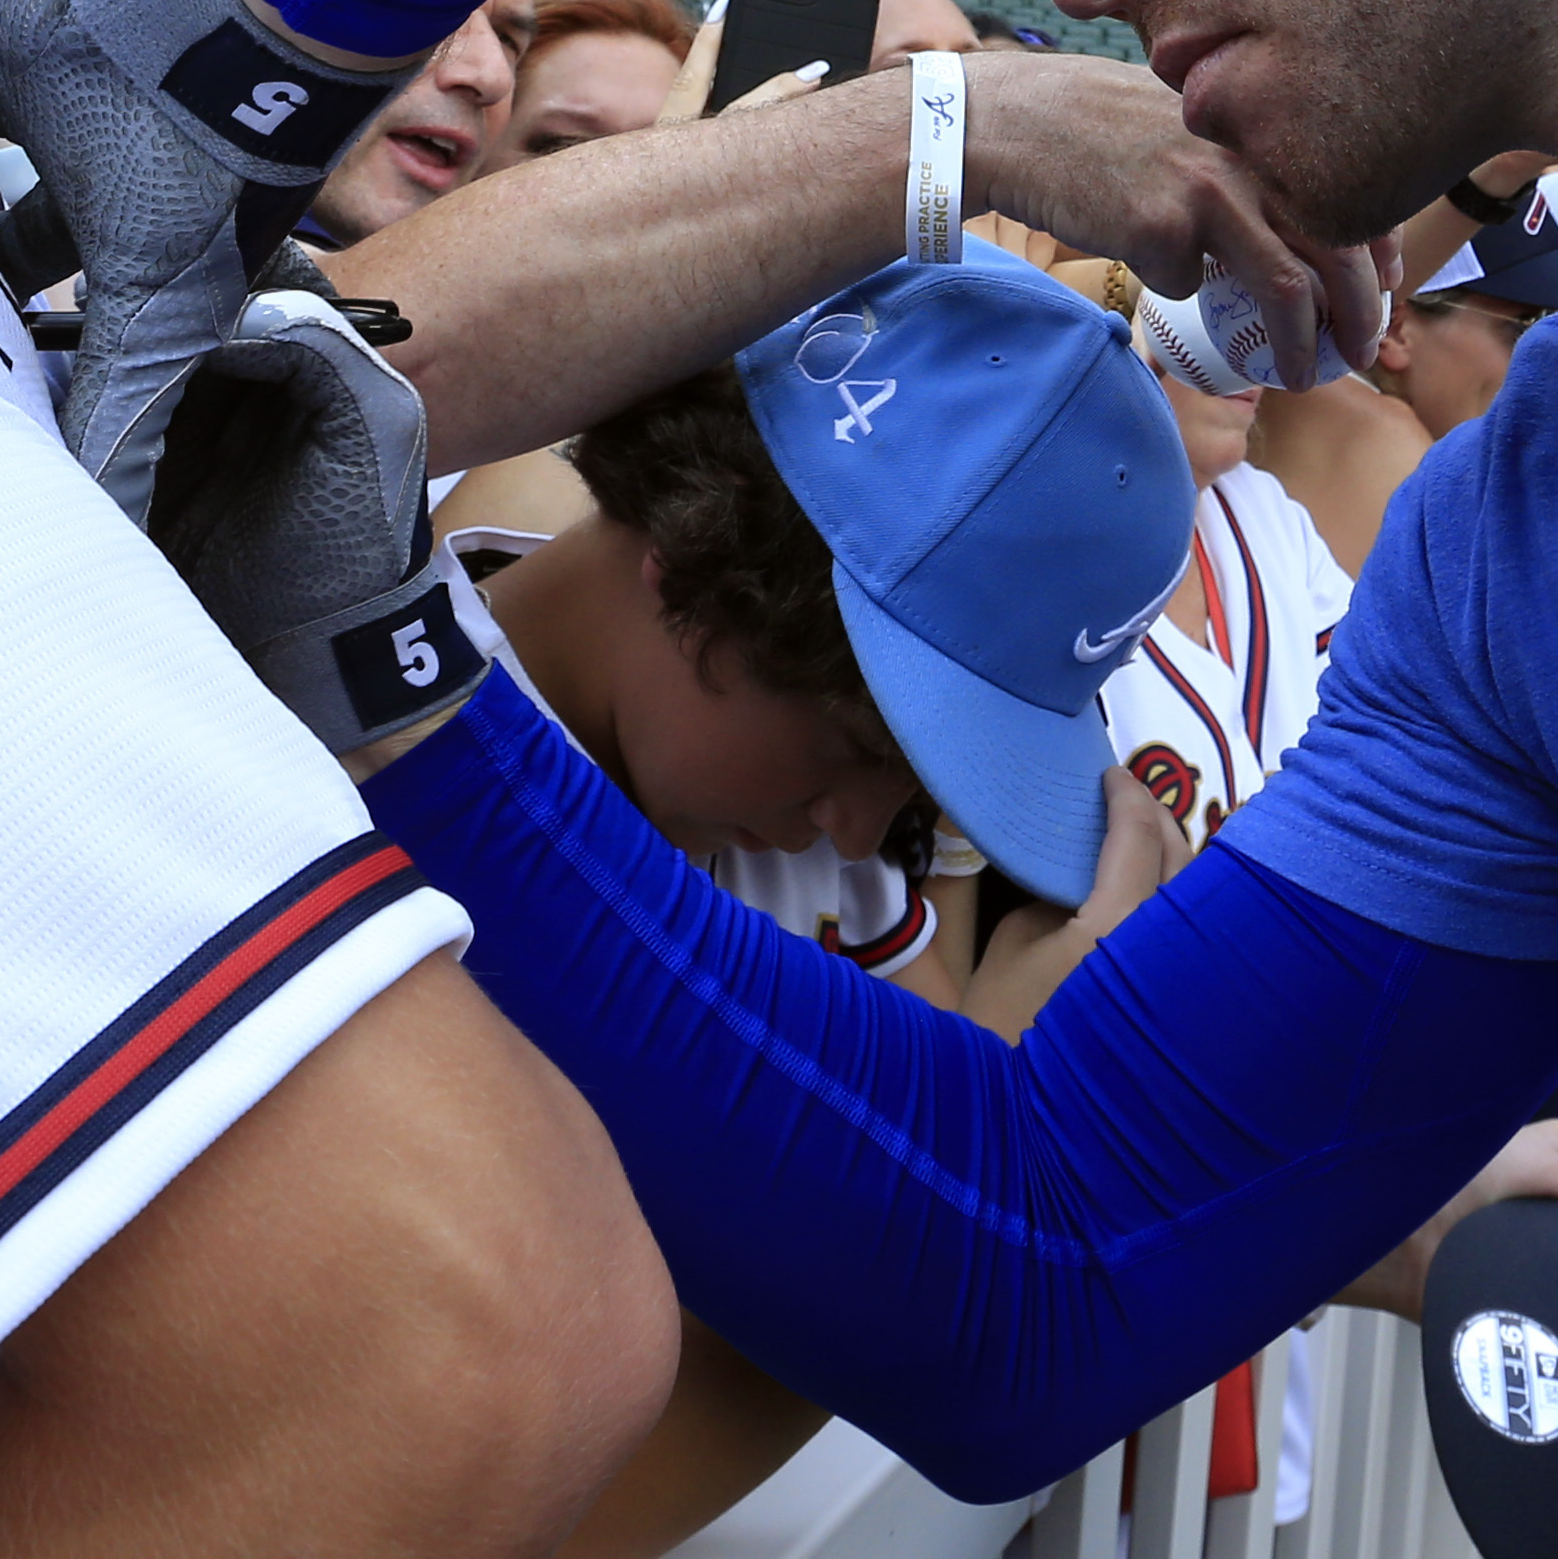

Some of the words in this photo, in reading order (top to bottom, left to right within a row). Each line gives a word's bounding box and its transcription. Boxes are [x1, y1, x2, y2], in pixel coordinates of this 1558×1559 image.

[231, 80, 310, 136] 5
[918, 160, 933, 232] PRACTICE
[933, 183, 949, 264] PERIENCE
[391, 618, 441, 688] 5
